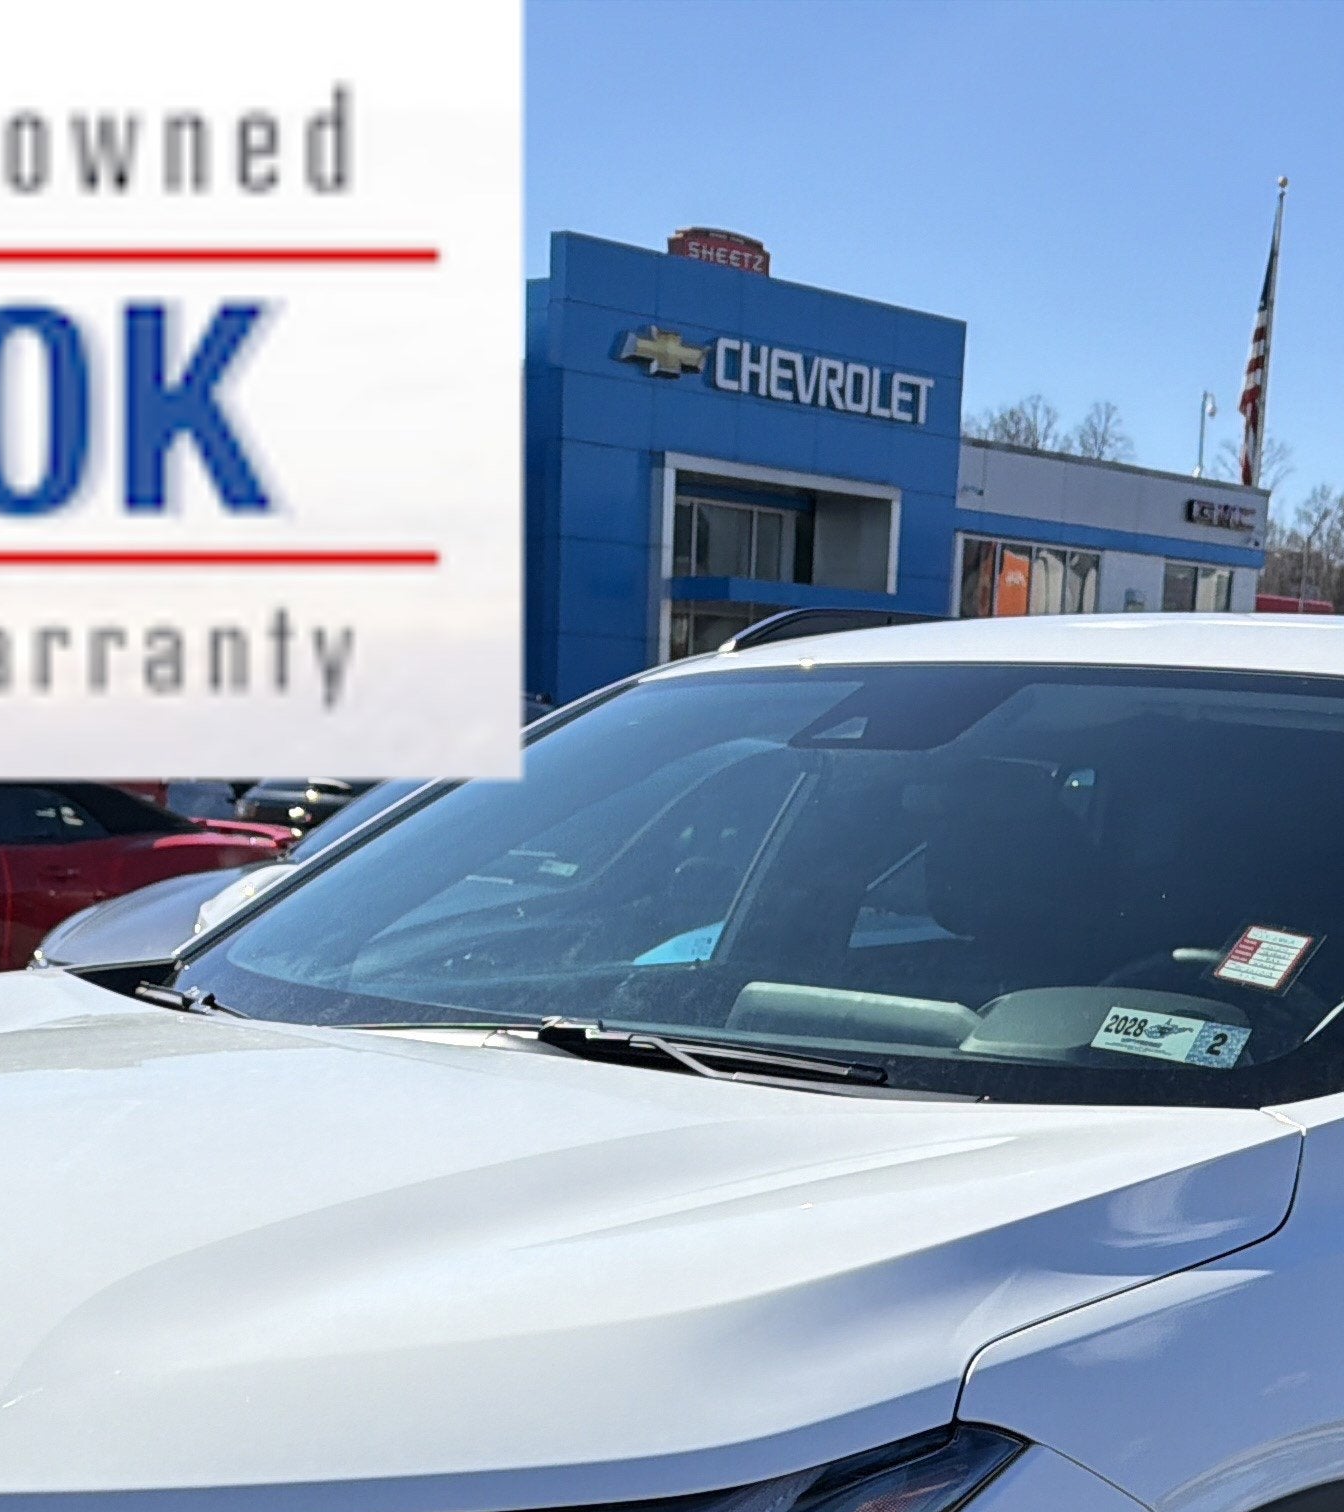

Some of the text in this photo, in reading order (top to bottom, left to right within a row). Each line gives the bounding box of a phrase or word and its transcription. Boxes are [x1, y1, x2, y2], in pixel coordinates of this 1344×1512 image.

[687, 241, 765, 273] SHEETZ
[713, 336, 935, 425] CHEVROLET
[1104, 1014, 1149, 1038] 2028
[1206, 1032, 1229, 1057] 2
